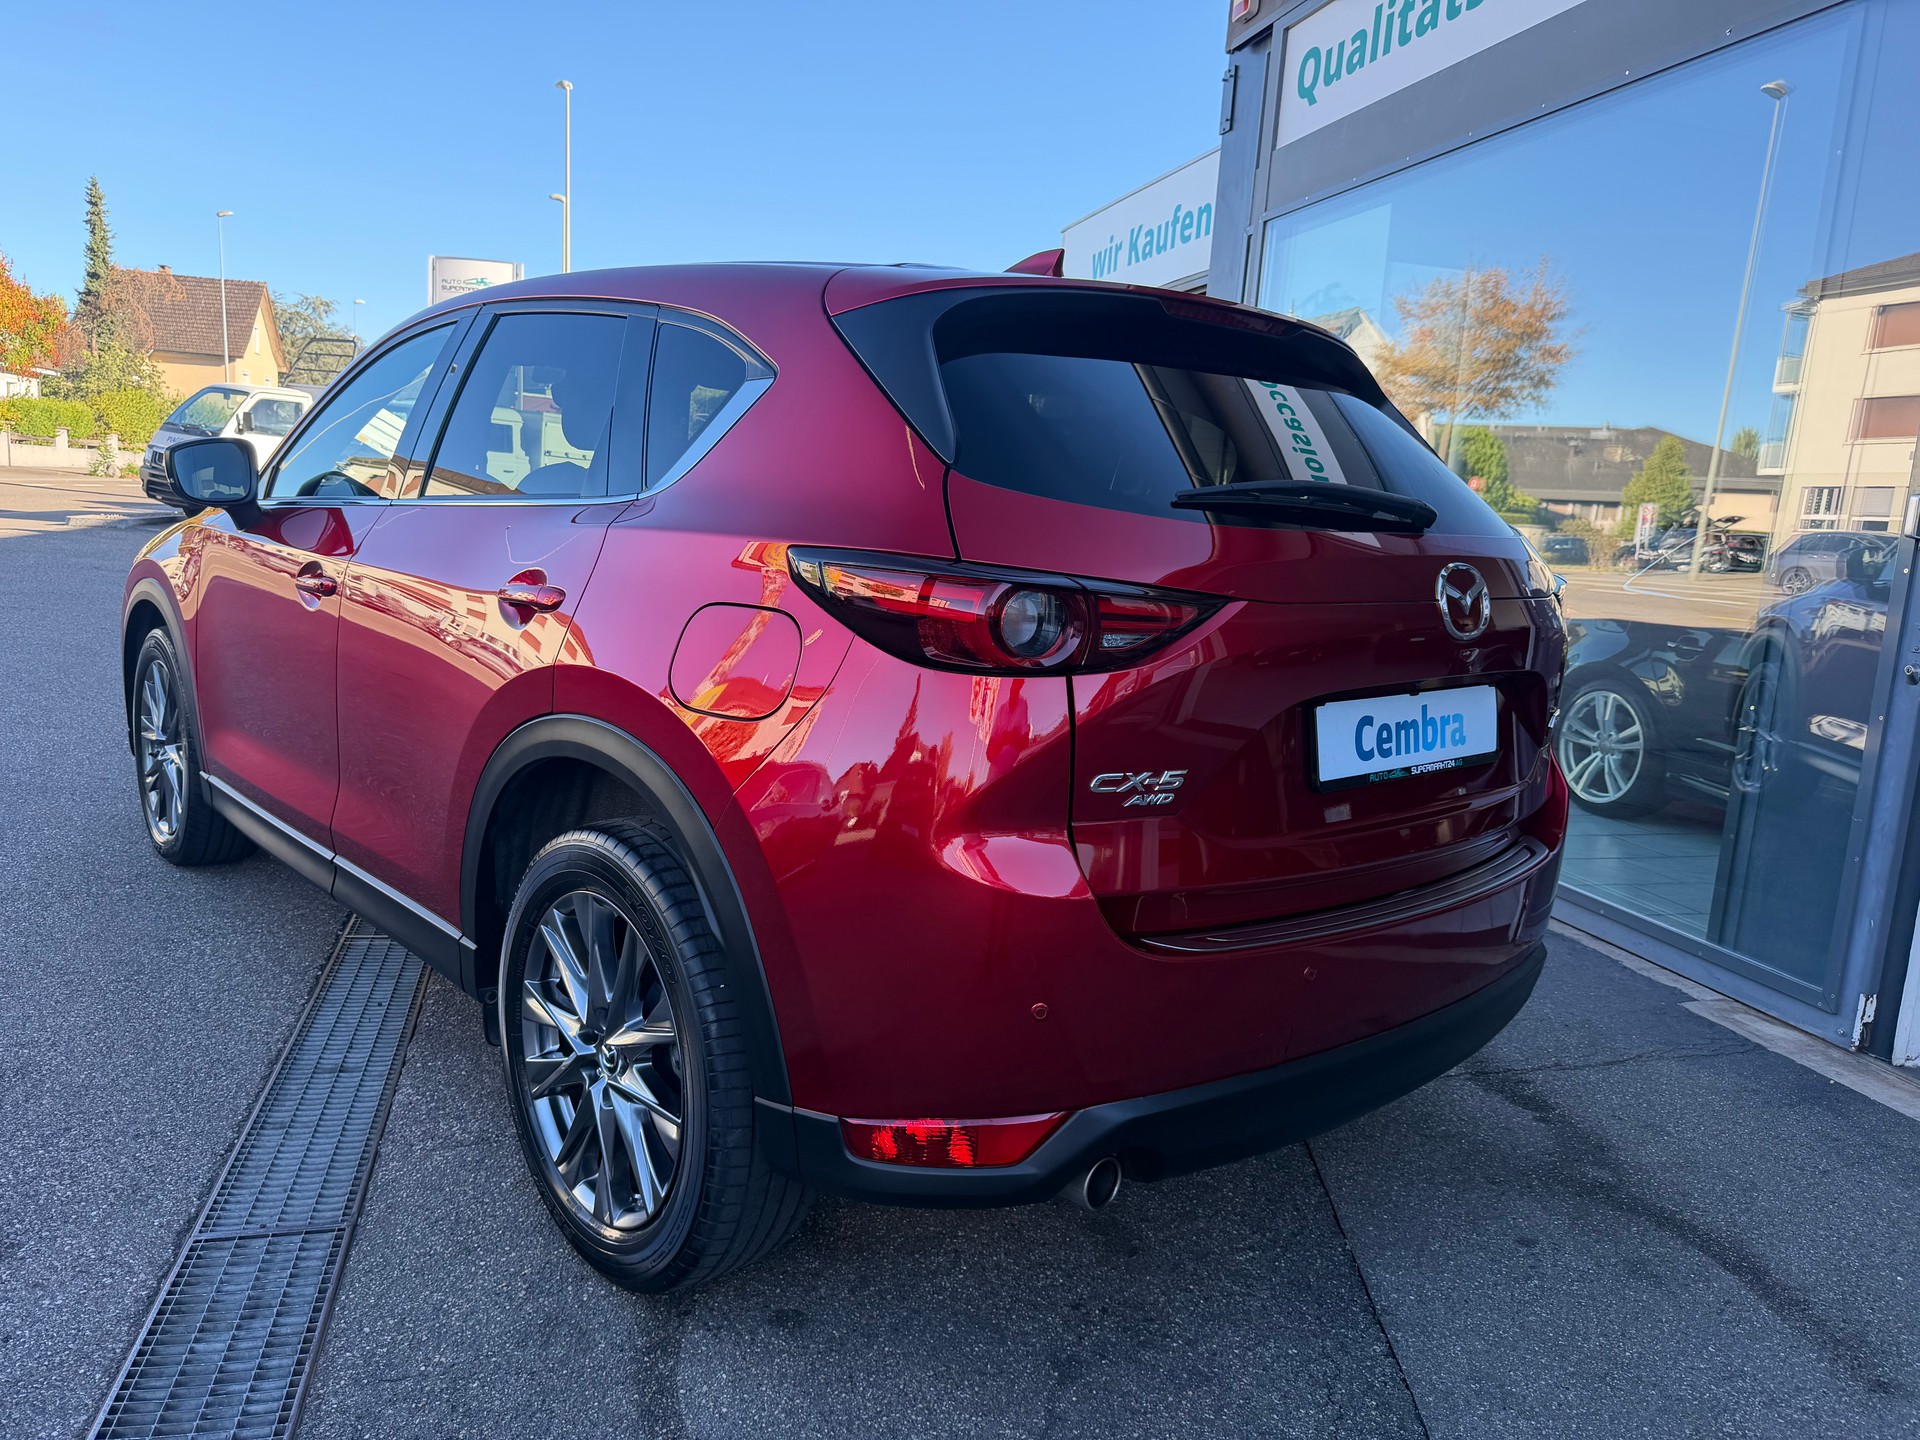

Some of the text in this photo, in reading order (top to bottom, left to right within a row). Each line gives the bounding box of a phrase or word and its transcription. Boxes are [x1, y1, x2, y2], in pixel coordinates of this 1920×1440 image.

[1092, 202, 1212, 279] wir Kaufen
[1355, 703, 1467, 762] Cembra
[1090, 769, 1189, 793] CX-5
[1369, 772, 1388, 783] AUTO
[1122, 792, 1175, 808] AWD
